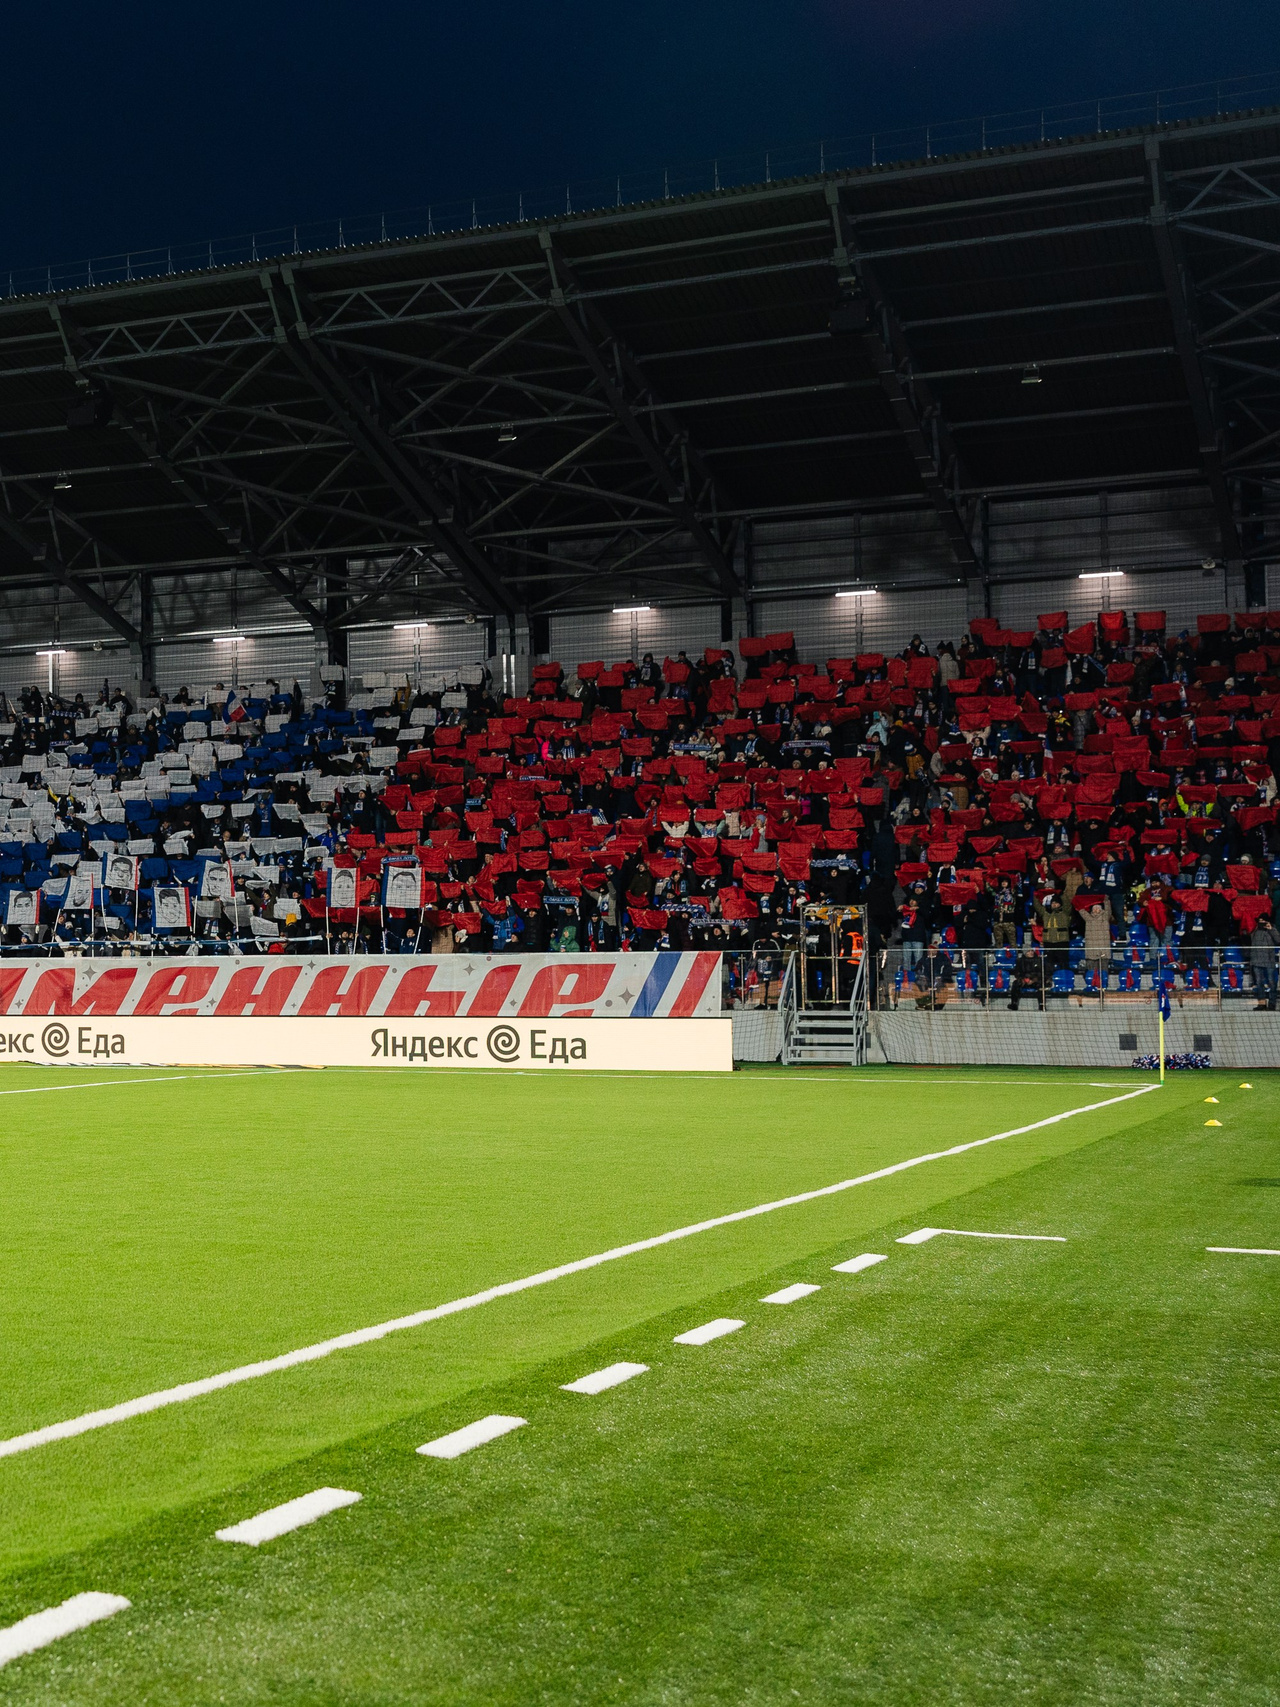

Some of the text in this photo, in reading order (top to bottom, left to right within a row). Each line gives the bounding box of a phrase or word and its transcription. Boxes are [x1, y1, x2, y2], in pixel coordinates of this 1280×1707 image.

[79, 1027, 124, 1058] Еда
[371, 1028, 586, 1063] Яндекс Еда
